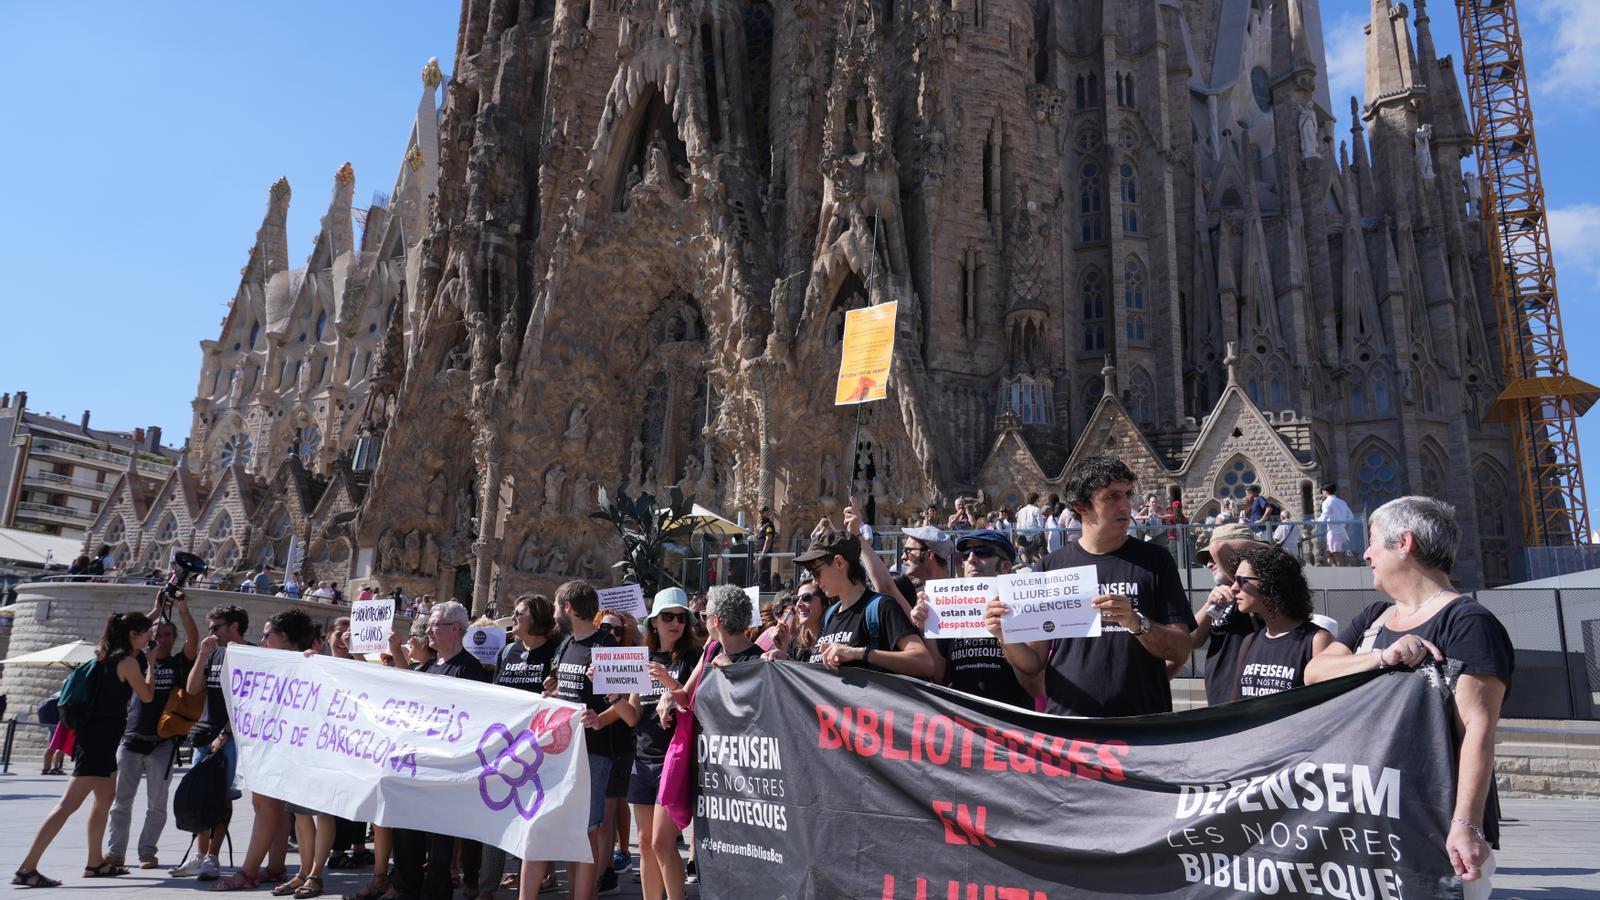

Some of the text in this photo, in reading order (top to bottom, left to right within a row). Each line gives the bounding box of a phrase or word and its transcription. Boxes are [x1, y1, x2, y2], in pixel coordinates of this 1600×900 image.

[951, 584, 975, 592] rates
[977, 583, 989, 591] de
[1010, 573, 1080, 587] VOLEM BIBLIOS
[1013, 586, 1080, 601] LLIURES DE
[1098, 582, 1138, 596] ENSEM
[935, 597, 987, 606] biblioteca
[1013, 599, 1082, 614] VIOLÈNCIES
[968, 608, 982, 616] als
[938, 620, 986, 630] despatxos
[964, 638, 1001, 648] NOSTRE
[595, 652, 645, 661] PROU XANTATGES
[603, 665, 611, 673] LA
[612, 665, 644, 673] PLANTILLA
[606, 677, 639, 685] MUNICIPAL
[1256, 678, 1292, 690] NOSTRES
[232, 668, 321, 712] DEFENSEM
[327, 690, 369, 721] ELS
[290, 726, 309, 747] DE
[316, 722, 417, 778] BARCELONA
[816, 703, 1129, 783] BIBLIOTEQUES
[697, 734, 781, 770] DEFENSEM
[698, 772, 785, 798] LES NOSTRES
[1175, 763, 1400, 819] DEFENSEM
[697, 795, 788, 831] BIBLIOTEQUES
[932, 800, 997, 848] EN
[1167, 821, 1401, 863] LES NOSTRES
[701, 838, 783, 864] #defensemBibliosBcn
